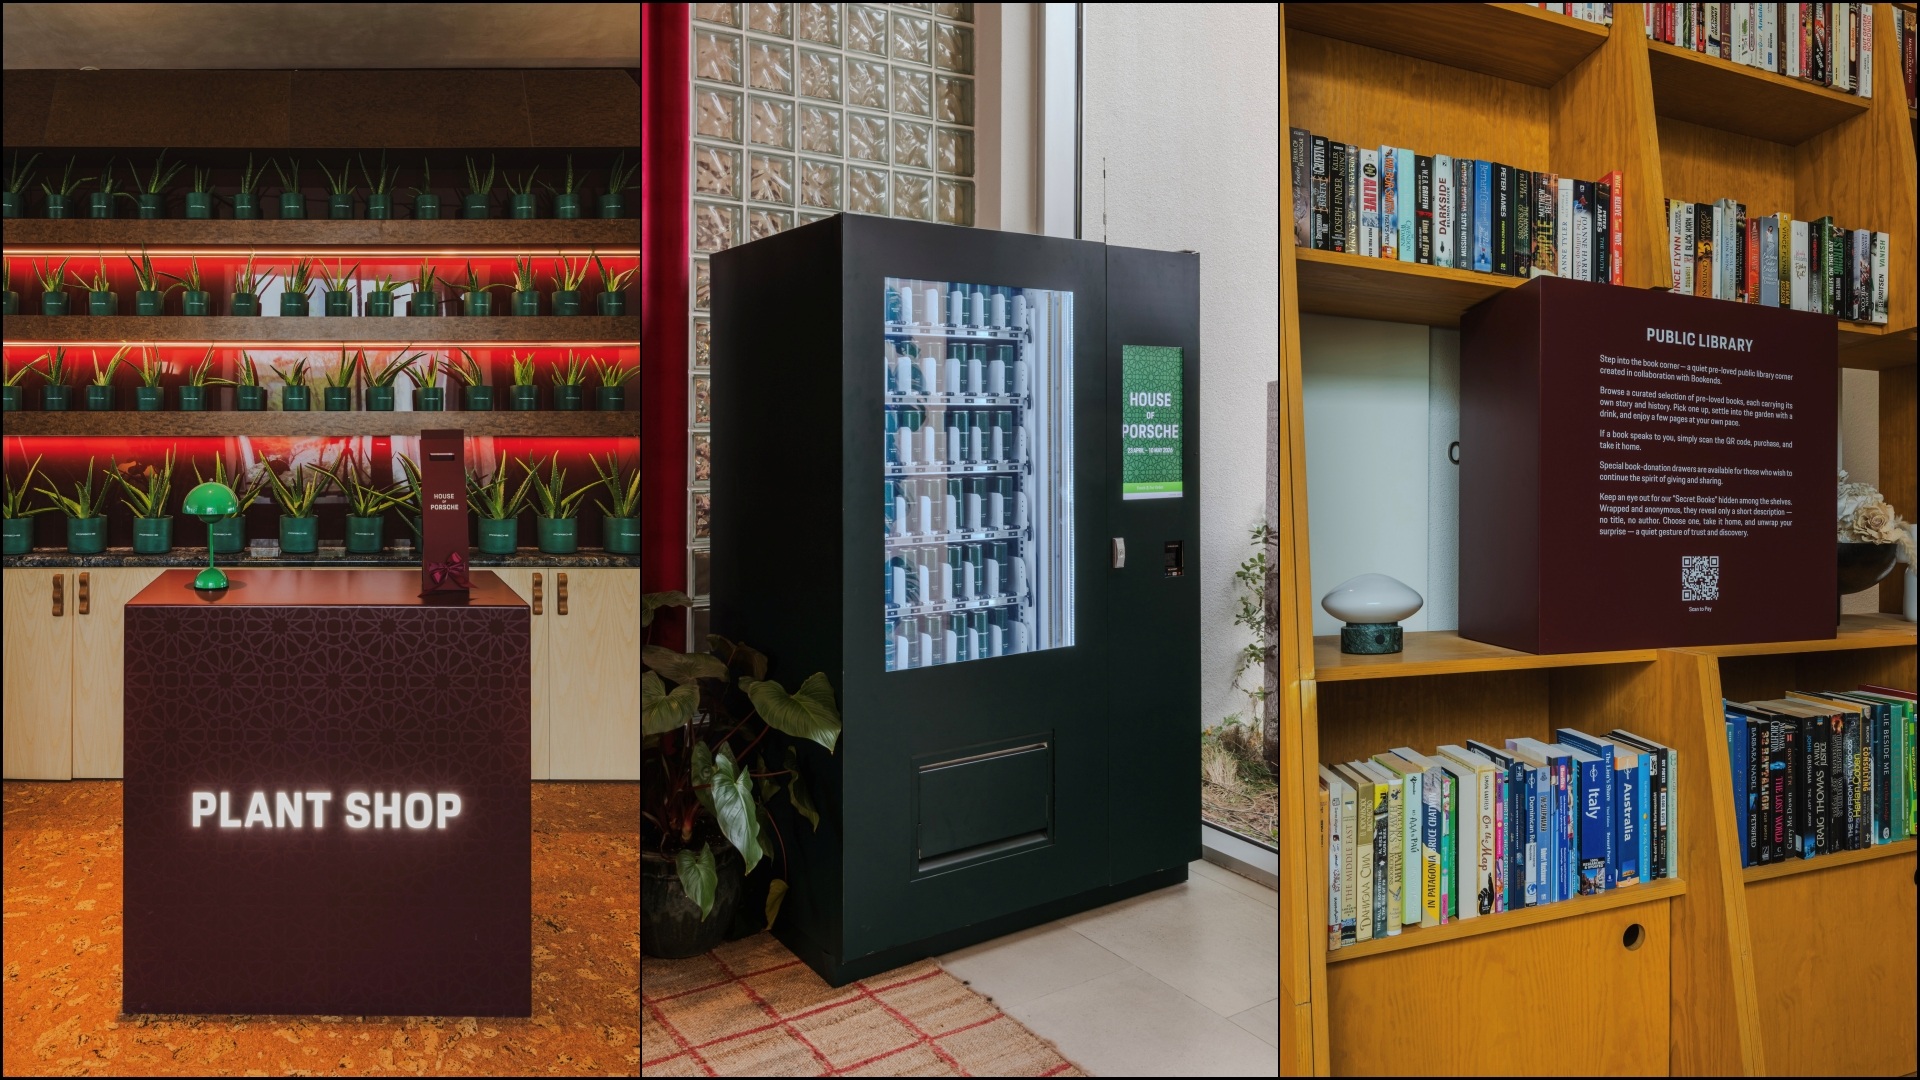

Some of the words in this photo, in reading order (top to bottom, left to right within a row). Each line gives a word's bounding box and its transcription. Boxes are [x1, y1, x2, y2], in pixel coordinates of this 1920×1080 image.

[1385, 158, 1394, 189] WILBUR
[1335, 178, 1343, 204] FINDER
[1364, 178, 1376, 212] ALIVE
[1385, 190, 1394, 214] SMITH
[1439, 178, 1447, 235] DARKSIDE
[1334, 207, 1343, 233] JOSEPH
[1646, 327, 1695, 346] PUBLIC
[1699, 333, 1753, 352] LIBRARY
[1599, 354, 1616, 365] Step
[1616, 355, 1630, 364] into
[1630, 357, 1642, 366] the
[1642, 358, 1658, 367] book
[1659, 361, 1680, 369] corner
[1691, 364, 1707, 372] quiet
[1708, 366, 1737, 375] pre-loved
[1737, 368, 1755, 377] public
[1756, 369, 1774, 380] library
[1599, 367, 1625, 375] created
[1626, 368, 1632, 376] in
[1633, 369, 1675, 380] collaboration
[1675, 373, 1690, 381] with
[1691, 373, 1722, 384] Bookends.
[1130, 392, 1171, 406] HOUSE
[1600, 385, 1624, 395] Browse
[1631, 390, 1656, 398] curated
[1657, 391, 1686, 400] selection
[1687, 393, 1694, 401] of
[1695, 395, 1724, 403] pre-loved
[1725, 396, 1745, 406] books,
[1761, 400, 1784, 410] carrying
[1785, 401, 1793, 409] its
[1615, 399, 1633, 409] story
[1634, 400, 1646, 408] and
[1647, 401, 1671, 412] history.
[1673, 403, 1686, 411] Pick
[1730, 407, 1742, 415] into
[1754, 408, 1774, 418] garden
[1775, 409, 1788, 419] with
[1599, 409, 1618, 419] drink,
[1619, 411, 1631, 419] and
[1632, 411, 1650, 422] enjoy
[1656, 413, 1668, 421] few
[1669, 415, 1688, 424] pages
[1696, 417, 1710, 425] your
[1724, 419, 1740, 427] pace.
[1123, 424, 1178, 439] PORSCHE
[1599, 429, 1605, 437] If
[1612, 429, 1628, 438] book
[1630, 431, 1652, 440] speaks
[1662, 434, 1675, 442] you,
[1677, 434, 1697, 444] simply
[1714, 436, 1724, 444] the
[1725, 436, 1735, 444] QR
[1736, 438, 1752, 446] code,
[1753, 439, 1781, 448] purchase,
[1782, 440, 1792, 448] and
[1599, 441, 1614, 449] take
[1615, 441, 1620, 449] it
[1621, 441, 1641, 450] home.
[1761, 730, 1769, 745] 32
[1770, 721, 1780, 753] CRICHTON
[1778, 722, 1786, 751] MICHAEL
[1820, 742, 1828, 766] JUSTICE
[1761, 747, 1769, 811] BATTALION
[1852, 753, 1861, 785] Coben
[1884, 762, 1889, 776] ME
[1775, 776, 1783, 794] THE
[1816, 770, 1824, 814] THOMAS
[192, 792, 331, 828] PLANT
[346, 793, 462, 829] SHOP
[1428, 792, 1437, 826] CHATWIN
[1585, 788, 1600, 819] Italy
[1623, 782, 1633, 842] Australia
[1775, 795, 1783, 813] LOST
[1853, 786, 1861, 818] Harlan
[1482, 815, 1492, 829] On
[1775, 815, 1783, 843] WORLD
[1787, 815, 1792, 827] Me
[1816, 817, 1825, 847] CRAIG
[1428, 828, 1436, 852] BRUCE
[1482, 832, 1492, 844] the
[1478, 843, 1492, 872] Map
[1428, 855, 1436, 898] PATAGONIA
[1428, 899, 1436, 908] IN
